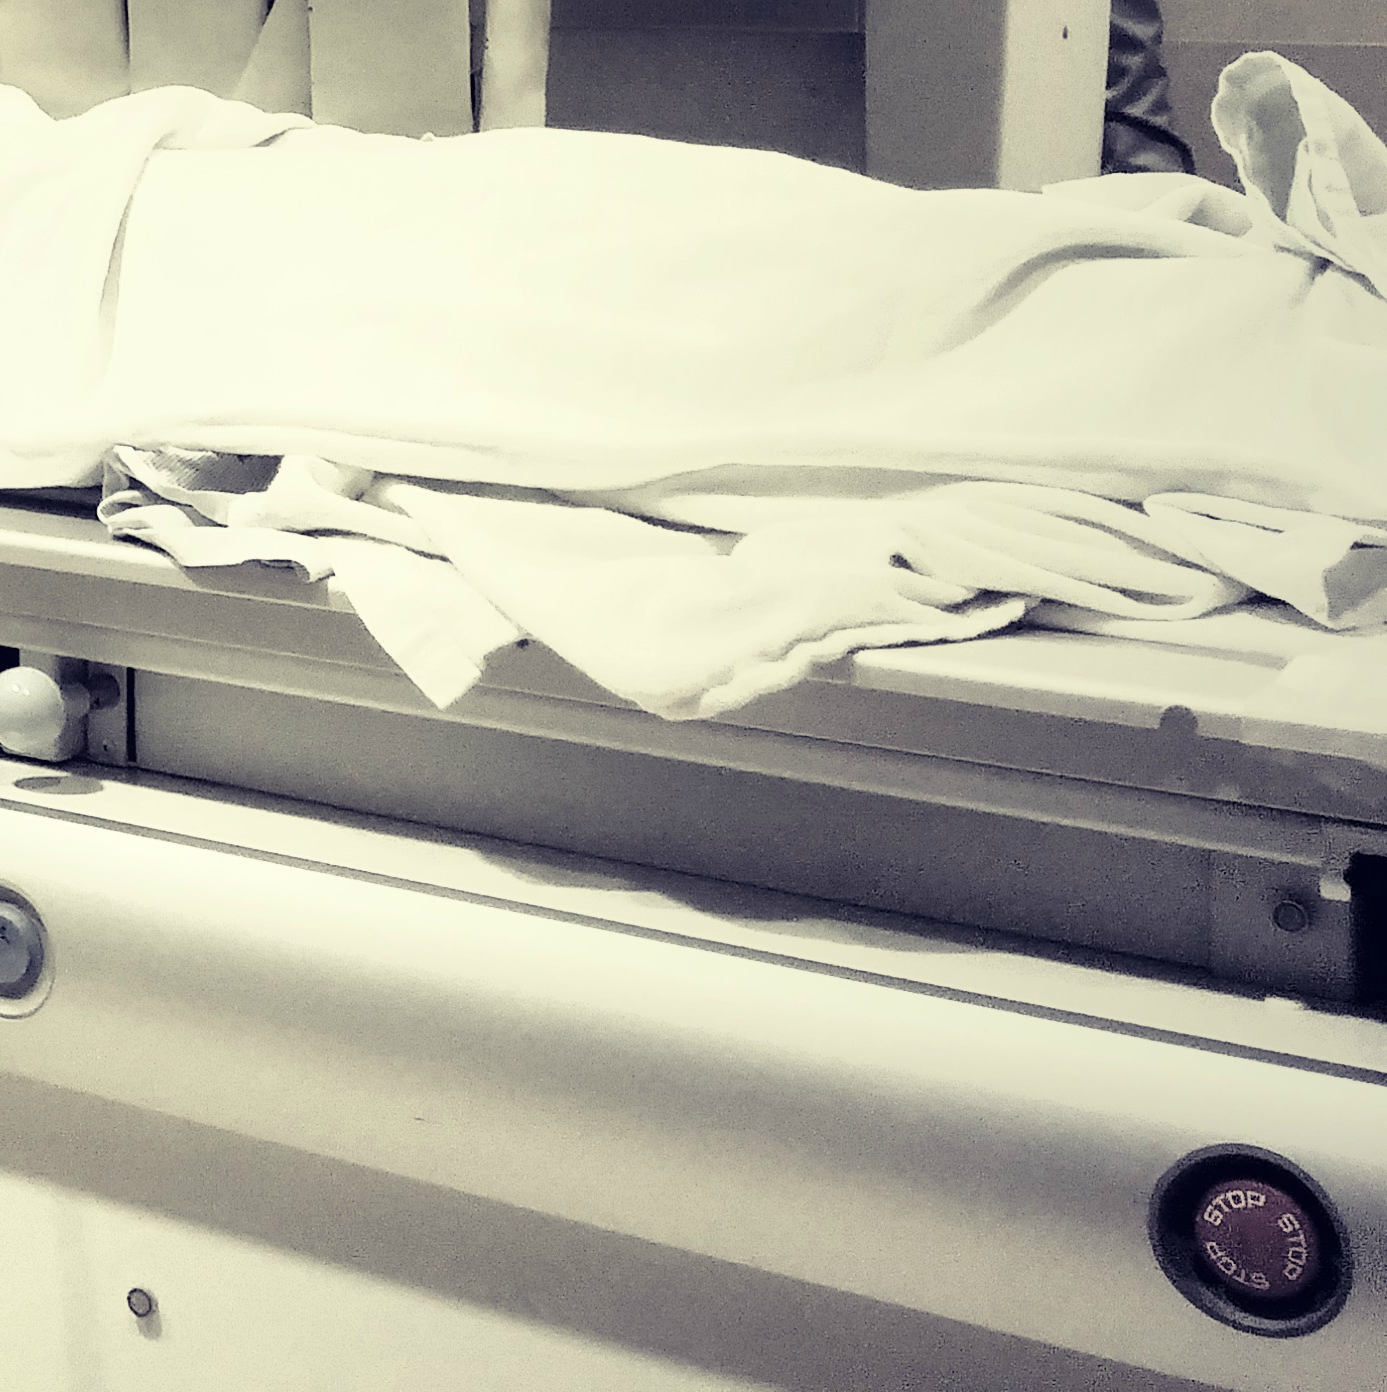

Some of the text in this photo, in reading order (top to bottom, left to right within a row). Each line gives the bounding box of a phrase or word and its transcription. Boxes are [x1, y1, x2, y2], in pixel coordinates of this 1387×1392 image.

[1203, 1189, 1266, 1226] STOP
[1205, 1241, 1270, 1290] STOP
[1277, 1213, 1308, 1280] STOP
